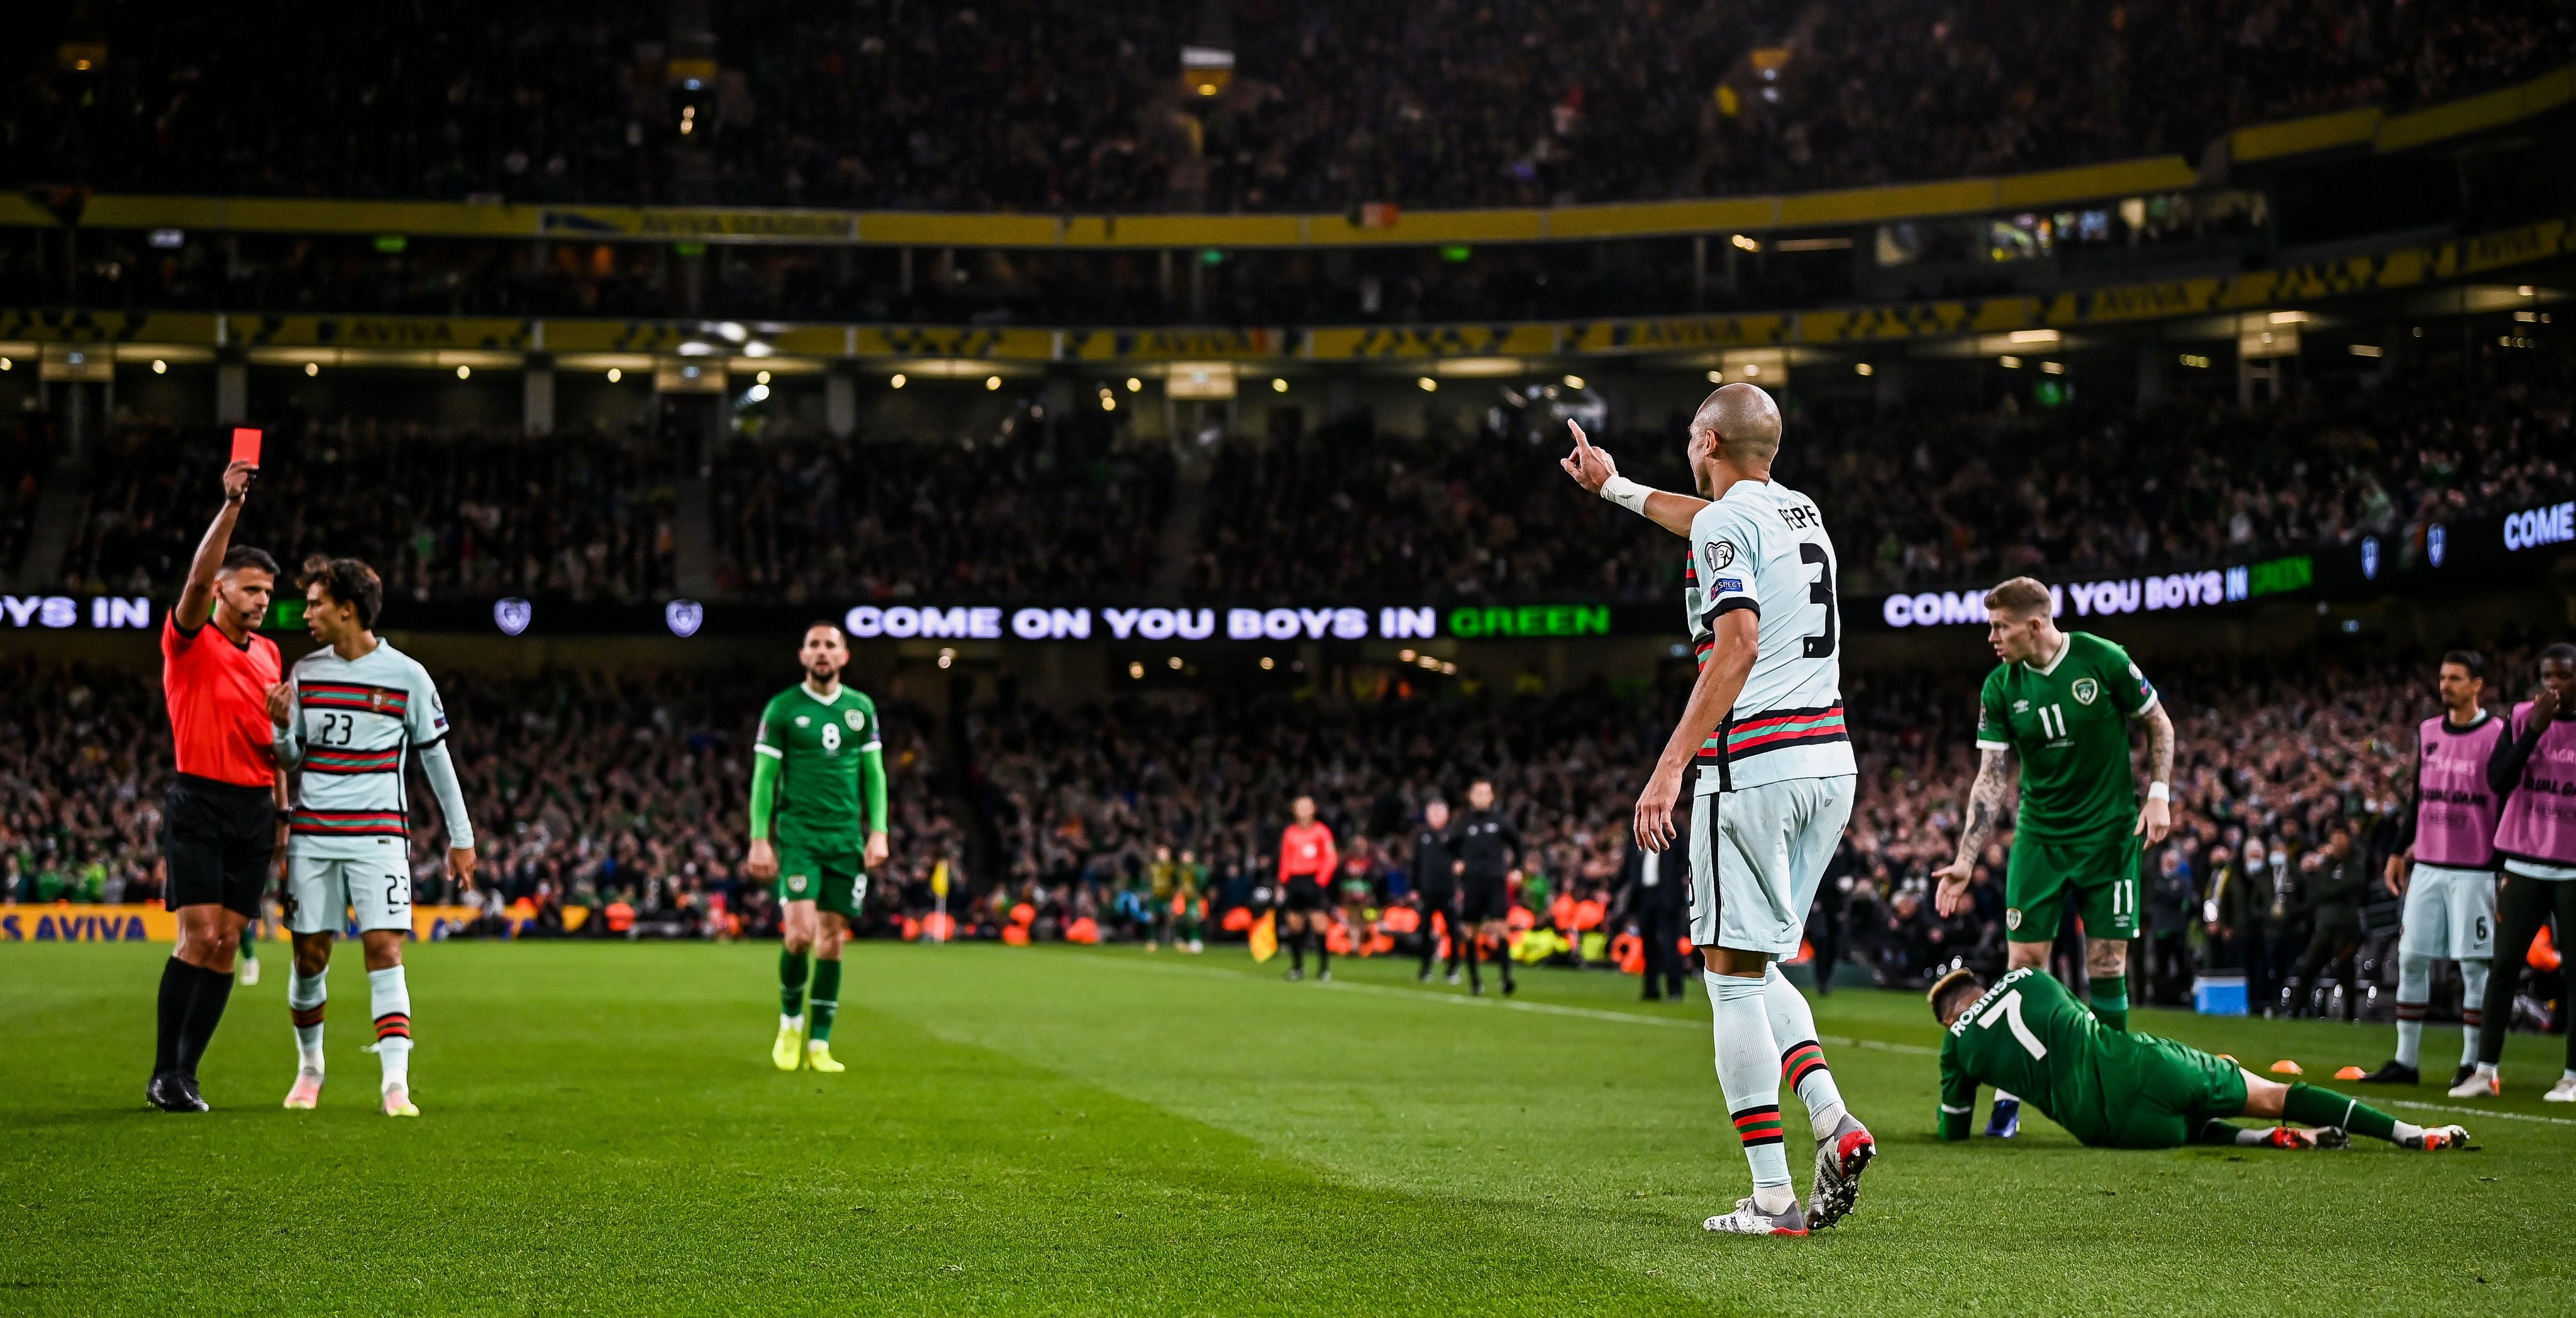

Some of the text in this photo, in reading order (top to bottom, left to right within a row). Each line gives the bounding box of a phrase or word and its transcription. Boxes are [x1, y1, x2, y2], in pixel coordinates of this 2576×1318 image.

[352, 321, 453, 341] AVIVA
[1777, 505, 1819, 531] PEPE
[2504, 501, 2576, 551] COME
[1800, 543, 1835, 658] 3
[2068, 578, 2141, 616] YOU
[2145, 570, 2223, 611] BOYS
[2225, 565, 2248, 602] IN
[0, 595, 150, 628] YS IN
[845, 604, 1610, 640] COME ON YOU BOYS IN GREEN
[322, 713, 353, 745] 23
[821, 723, 841, 750] 8
[2038, 703, 2067, 739] 11
[385, 875, 410, 905] 23
[851, 873, 867, 902] 8
[2113, 879, 2133, 915] 11
[36, 916, 147, 941] AVIVA
[2475, 915, 2487, 941] 6
[1950, 966, 2033, 1038] ROBINSON
[1977, 988, 2047, 1061] 7
